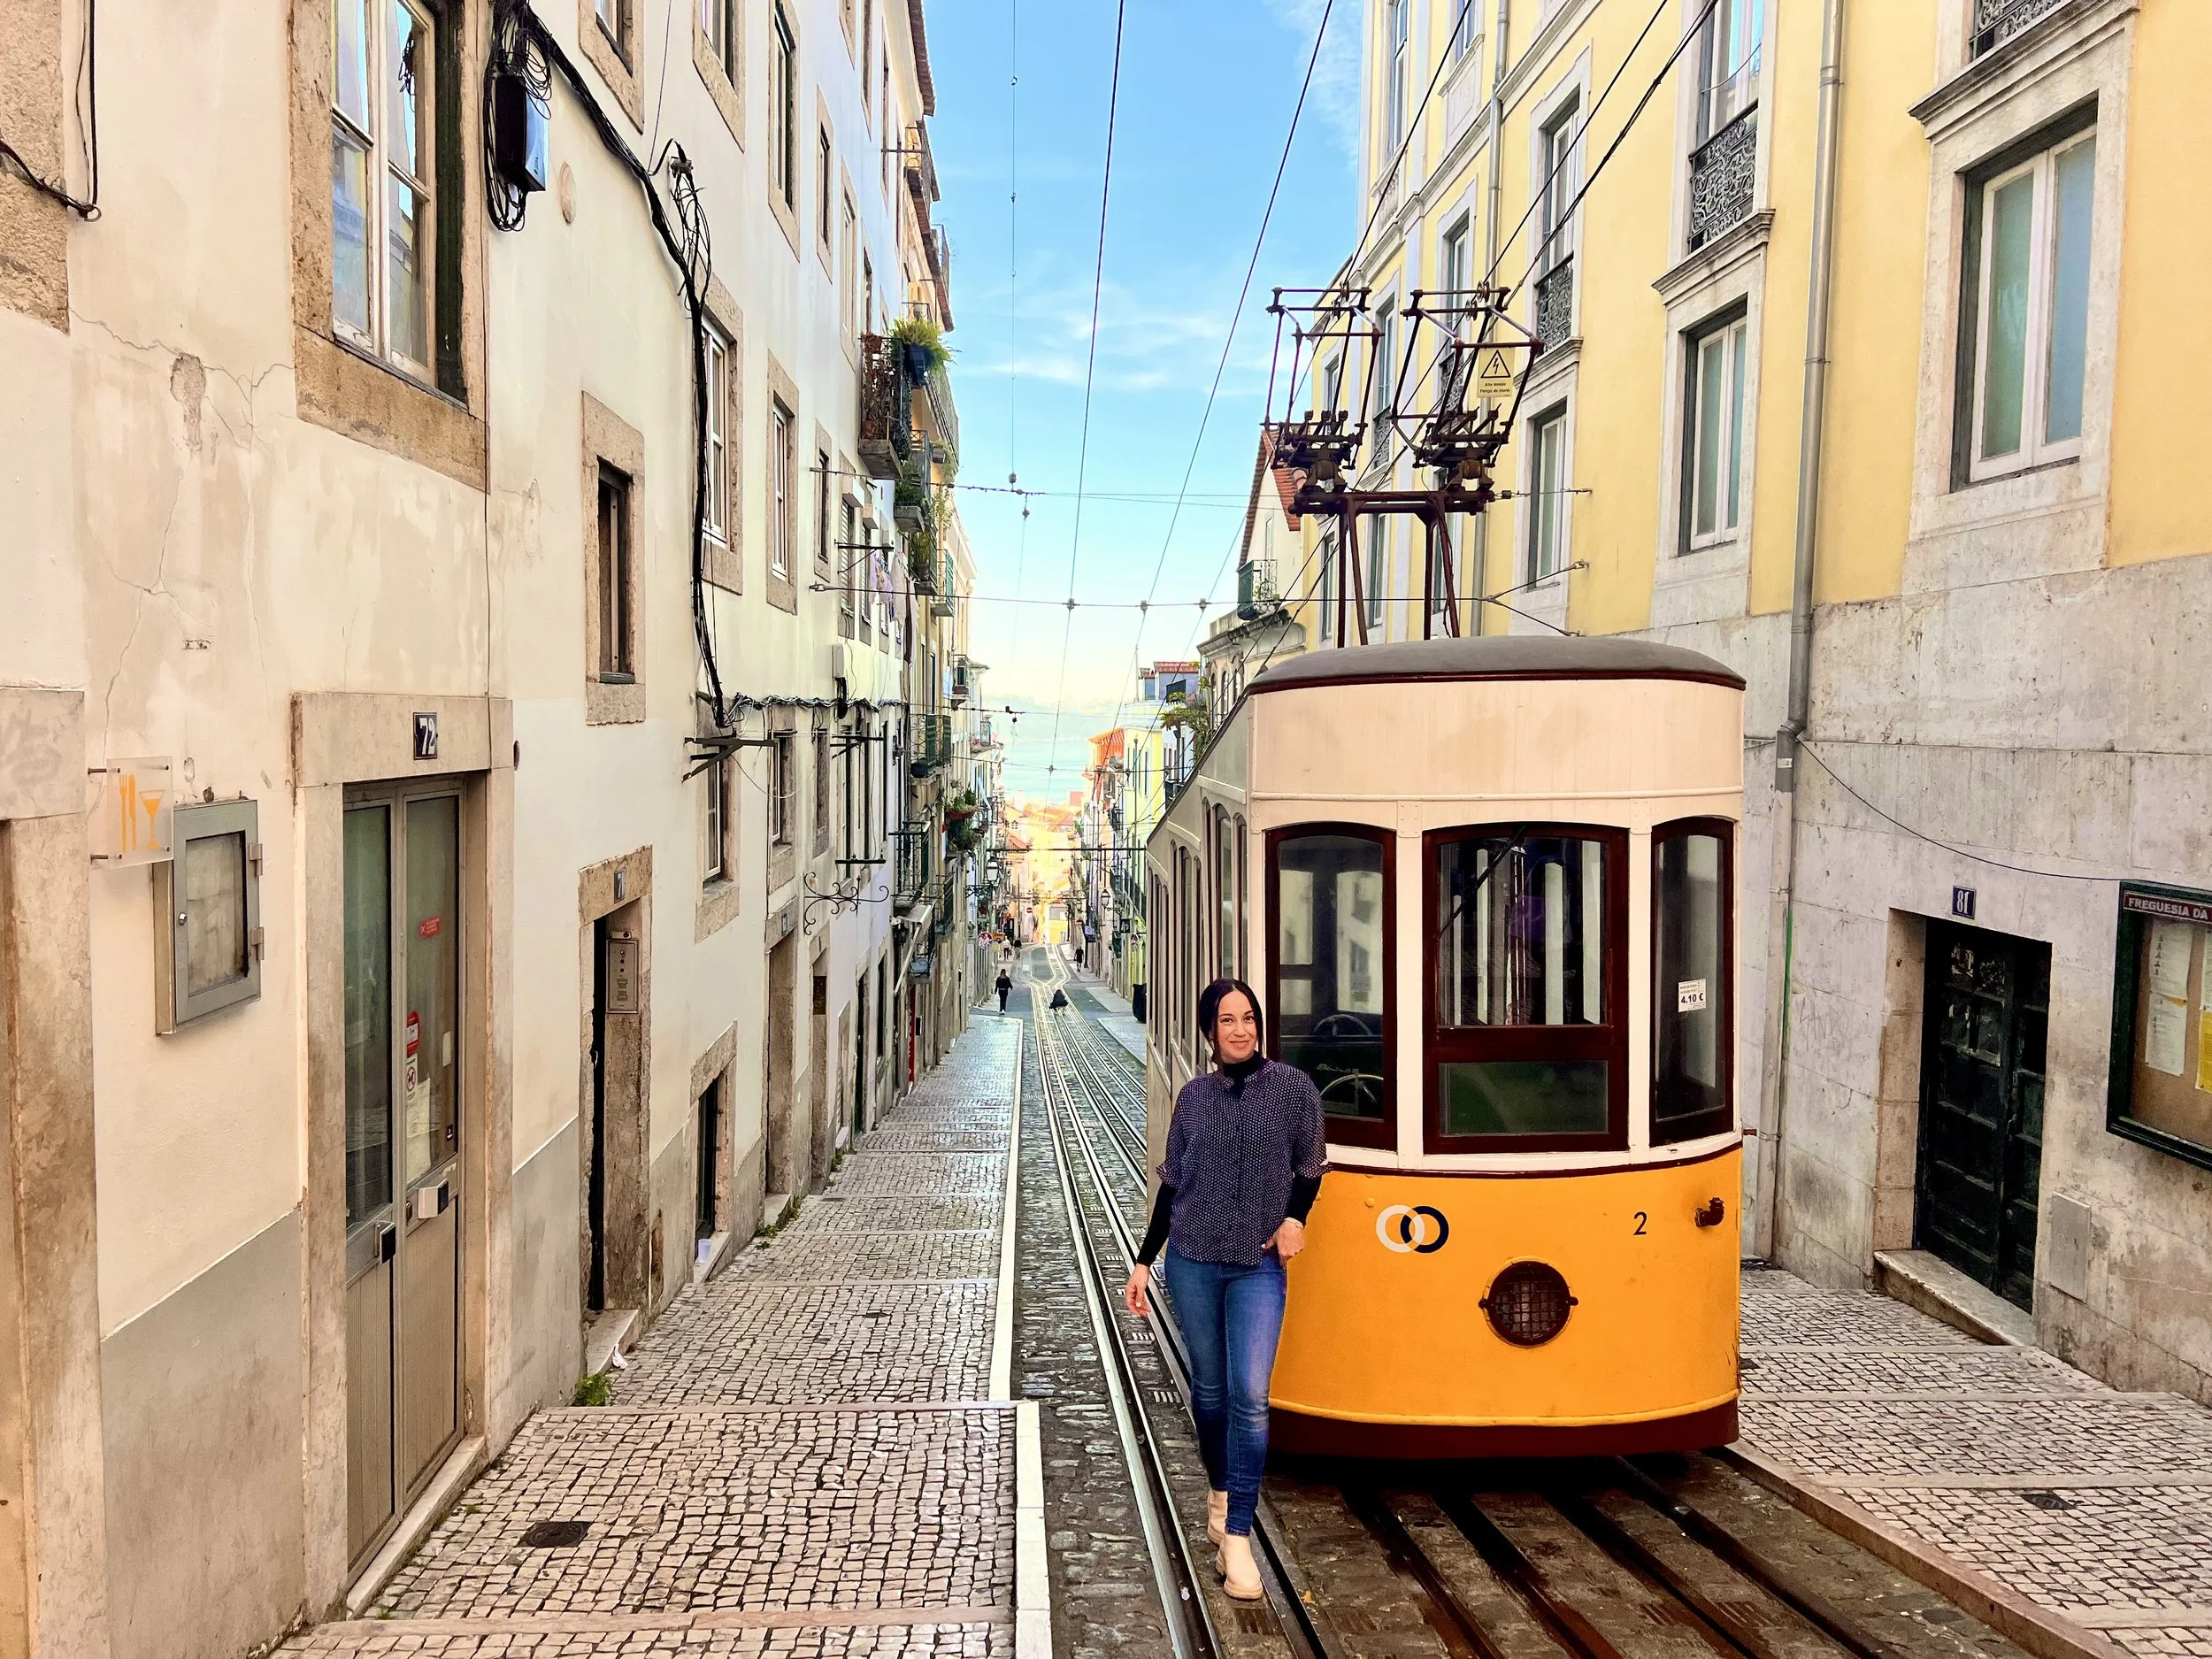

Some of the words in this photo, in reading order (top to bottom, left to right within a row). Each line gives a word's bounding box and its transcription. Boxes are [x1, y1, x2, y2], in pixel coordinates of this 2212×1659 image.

[419, 718, 434, 755] 72
[1956, 890, 1970, 914] 81
[2128, 897, 2190, 916] FREGUESIA
[2193, 908, 2208, 920] DA
[1681, 994, 1696, 1004] 4.10
[1633, 1211, 1647, 1235] 2
